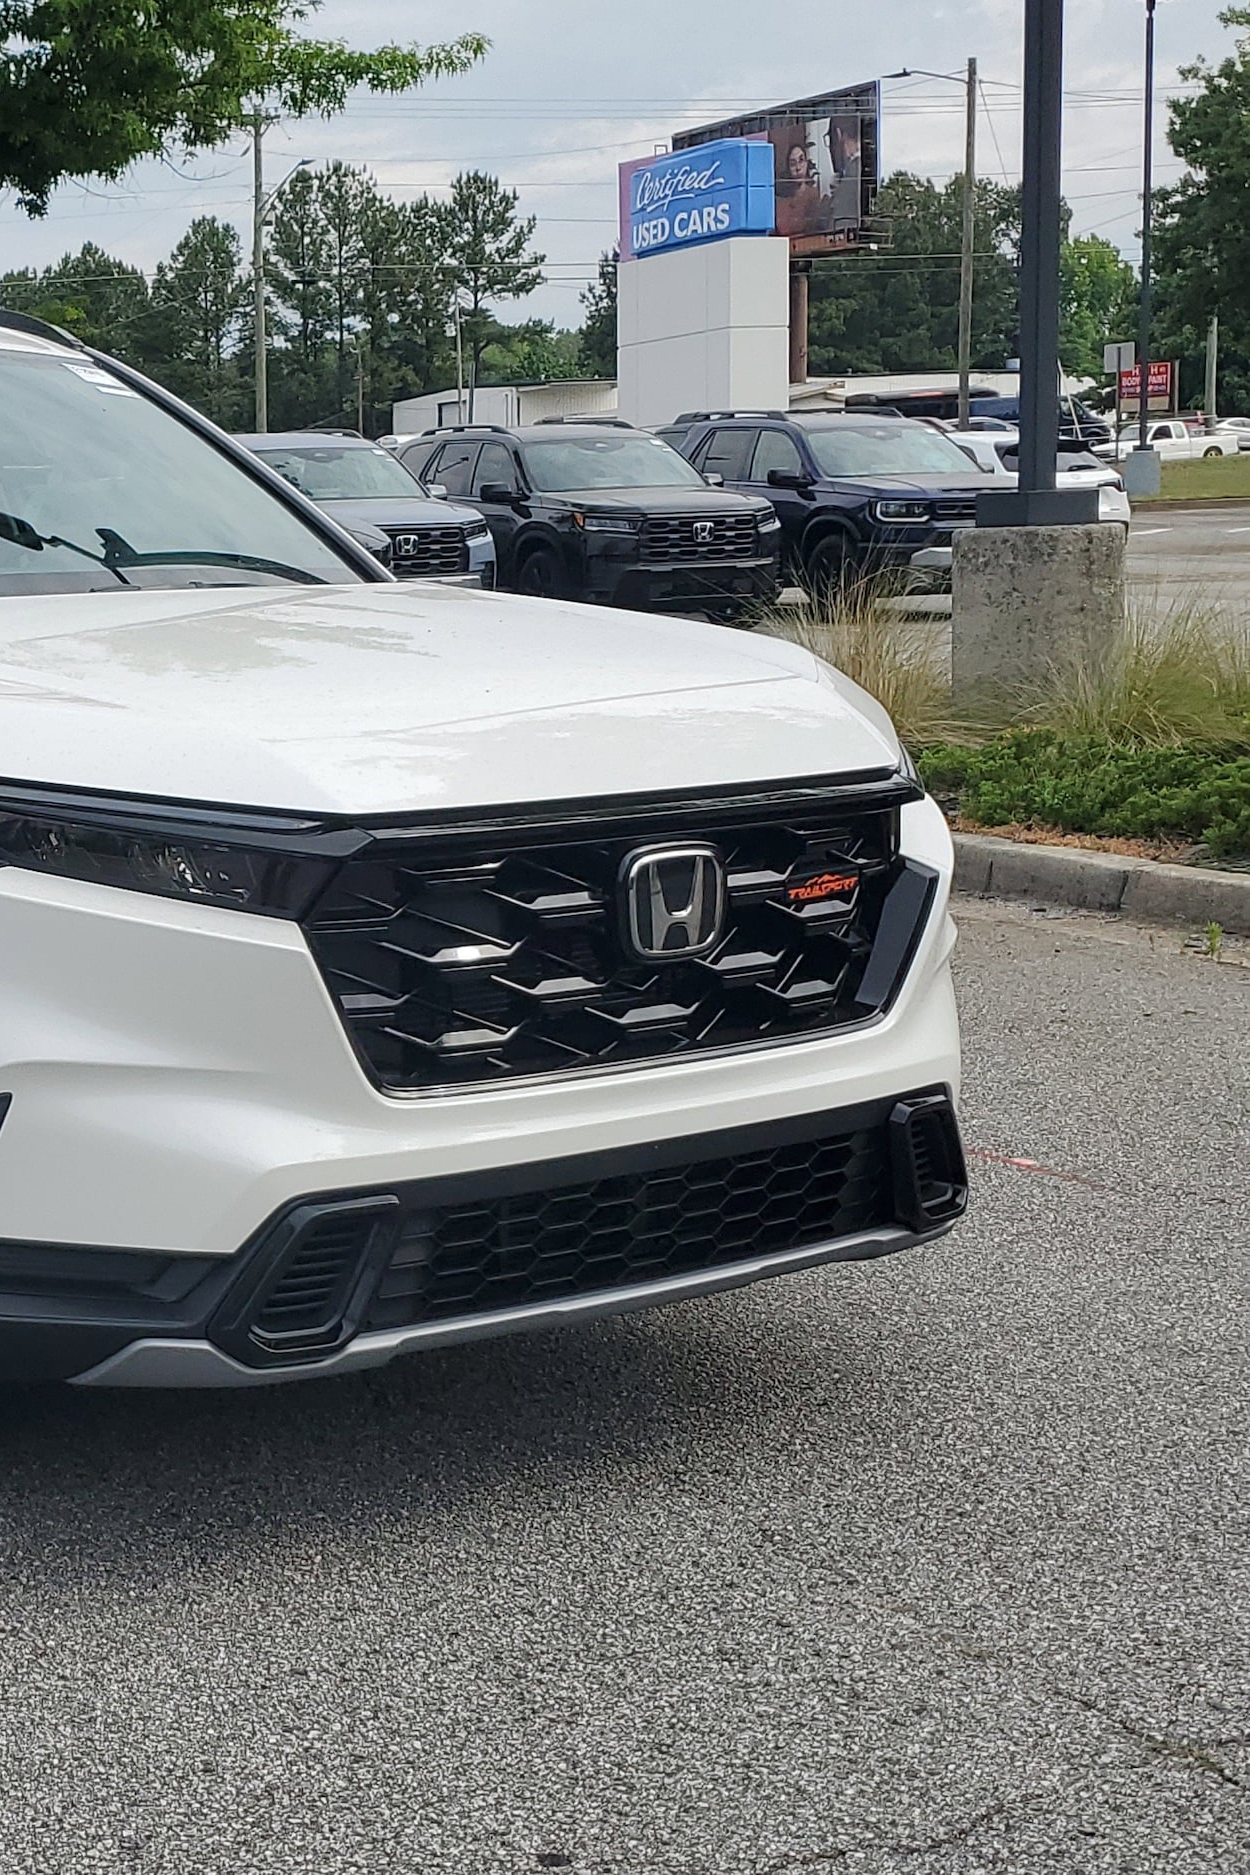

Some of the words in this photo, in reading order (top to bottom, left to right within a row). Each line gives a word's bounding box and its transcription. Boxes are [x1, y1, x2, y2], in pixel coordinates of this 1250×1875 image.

[636, 160, 725, 211] Certified
[632, 217, 670, 249] USED
[673, 203, 730, 238] CARS
